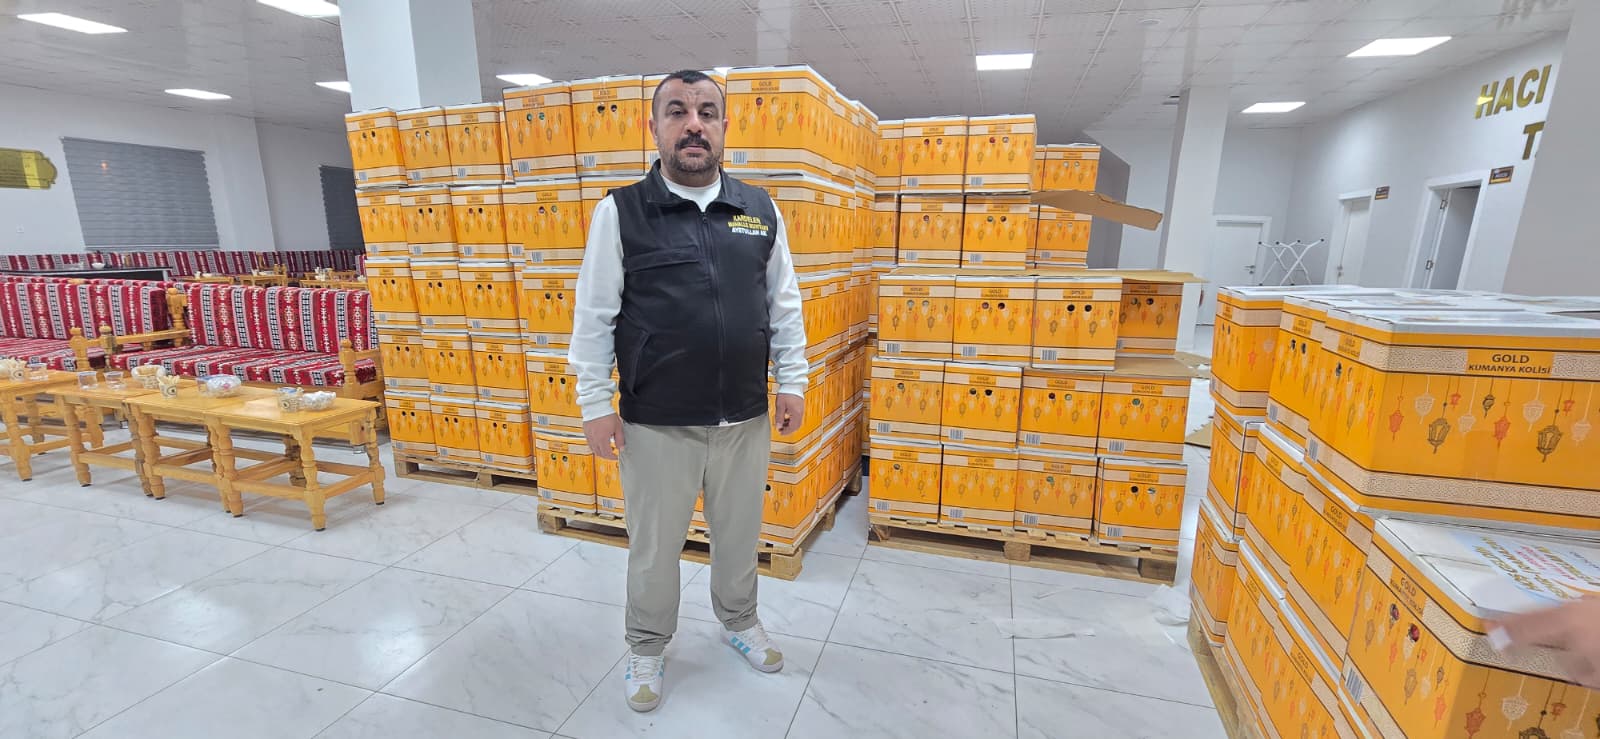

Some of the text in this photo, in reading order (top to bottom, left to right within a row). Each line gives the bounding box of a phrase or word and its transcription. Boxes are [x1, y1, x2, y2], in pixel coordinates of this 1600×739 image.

[1475, 64, 1552, 119] HACI
[1522, 121, 1546, 160] T
[1468, 364, 1516, 373] KUMANYA
[1491, 353, 1530, 364] GOLD
[1401, 577, 1417, 597] GOLD
